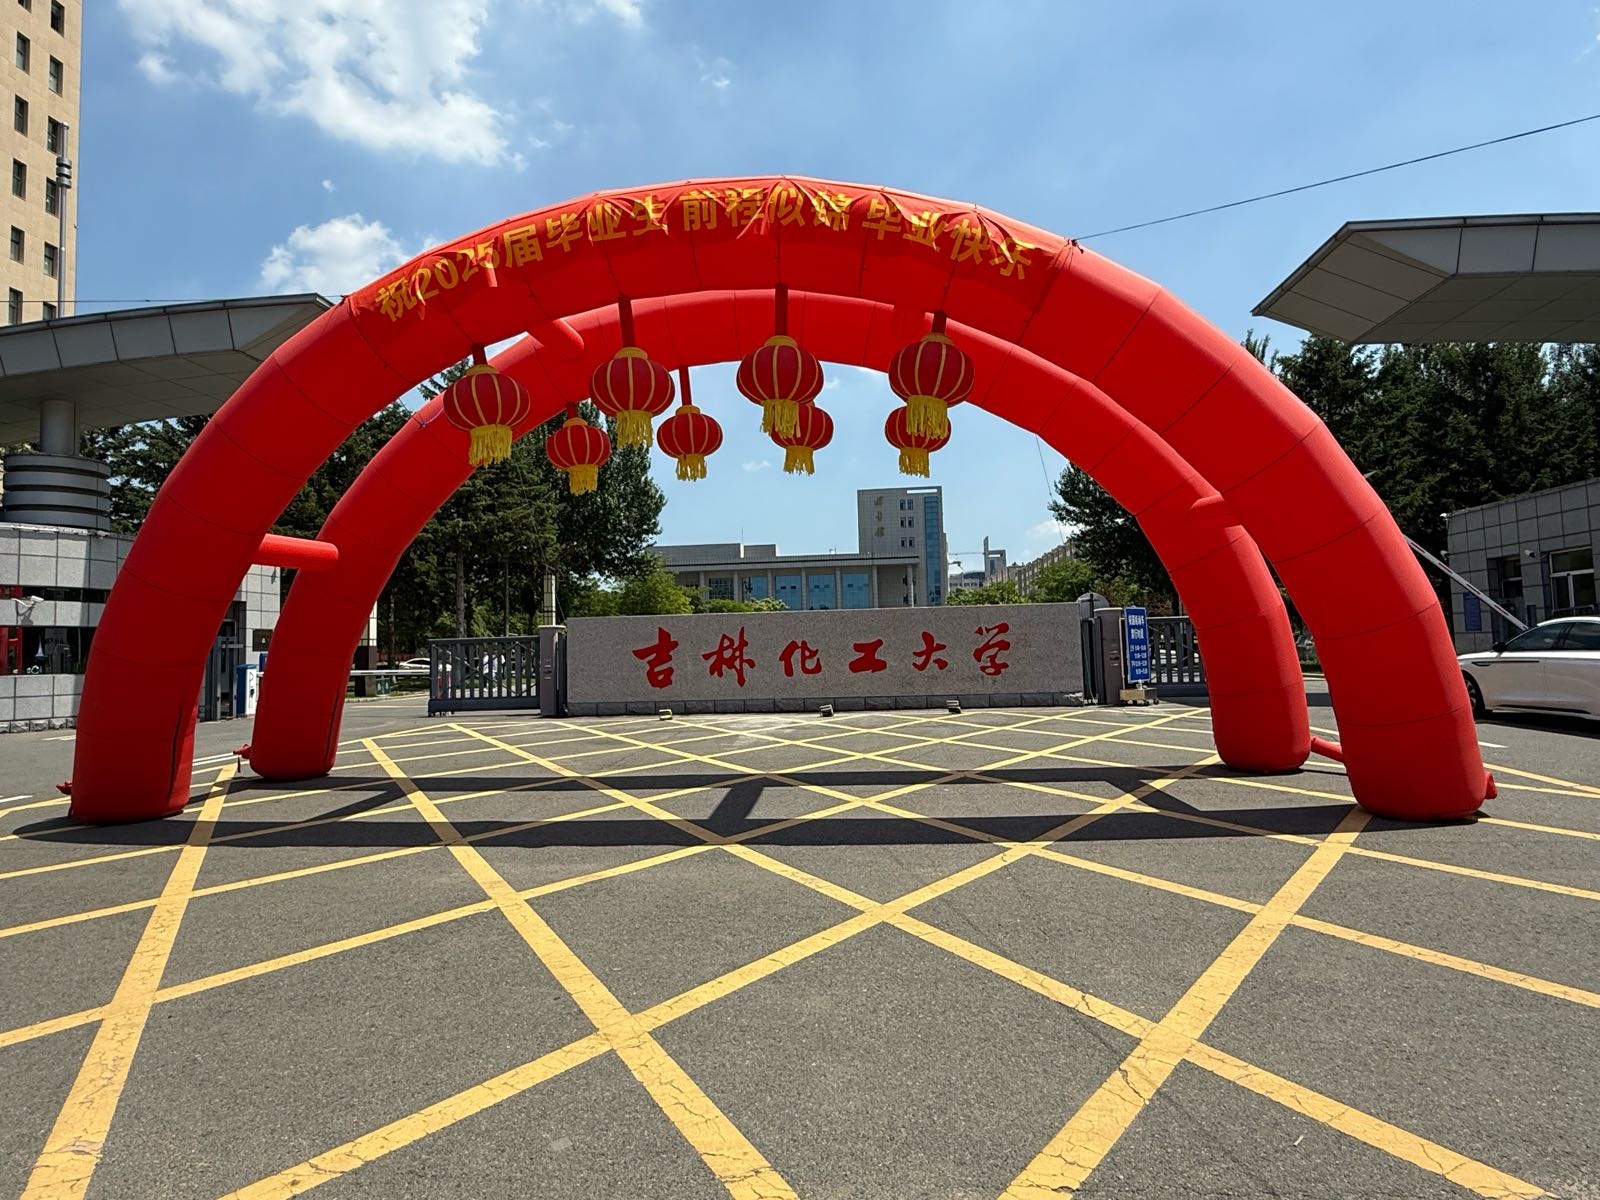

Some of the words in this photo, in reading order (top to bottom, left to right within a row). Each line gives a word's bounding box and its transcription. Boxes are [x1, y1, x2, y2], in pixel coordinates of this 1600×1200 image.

[632, 622, 1011, 689] 吉林化工大学
